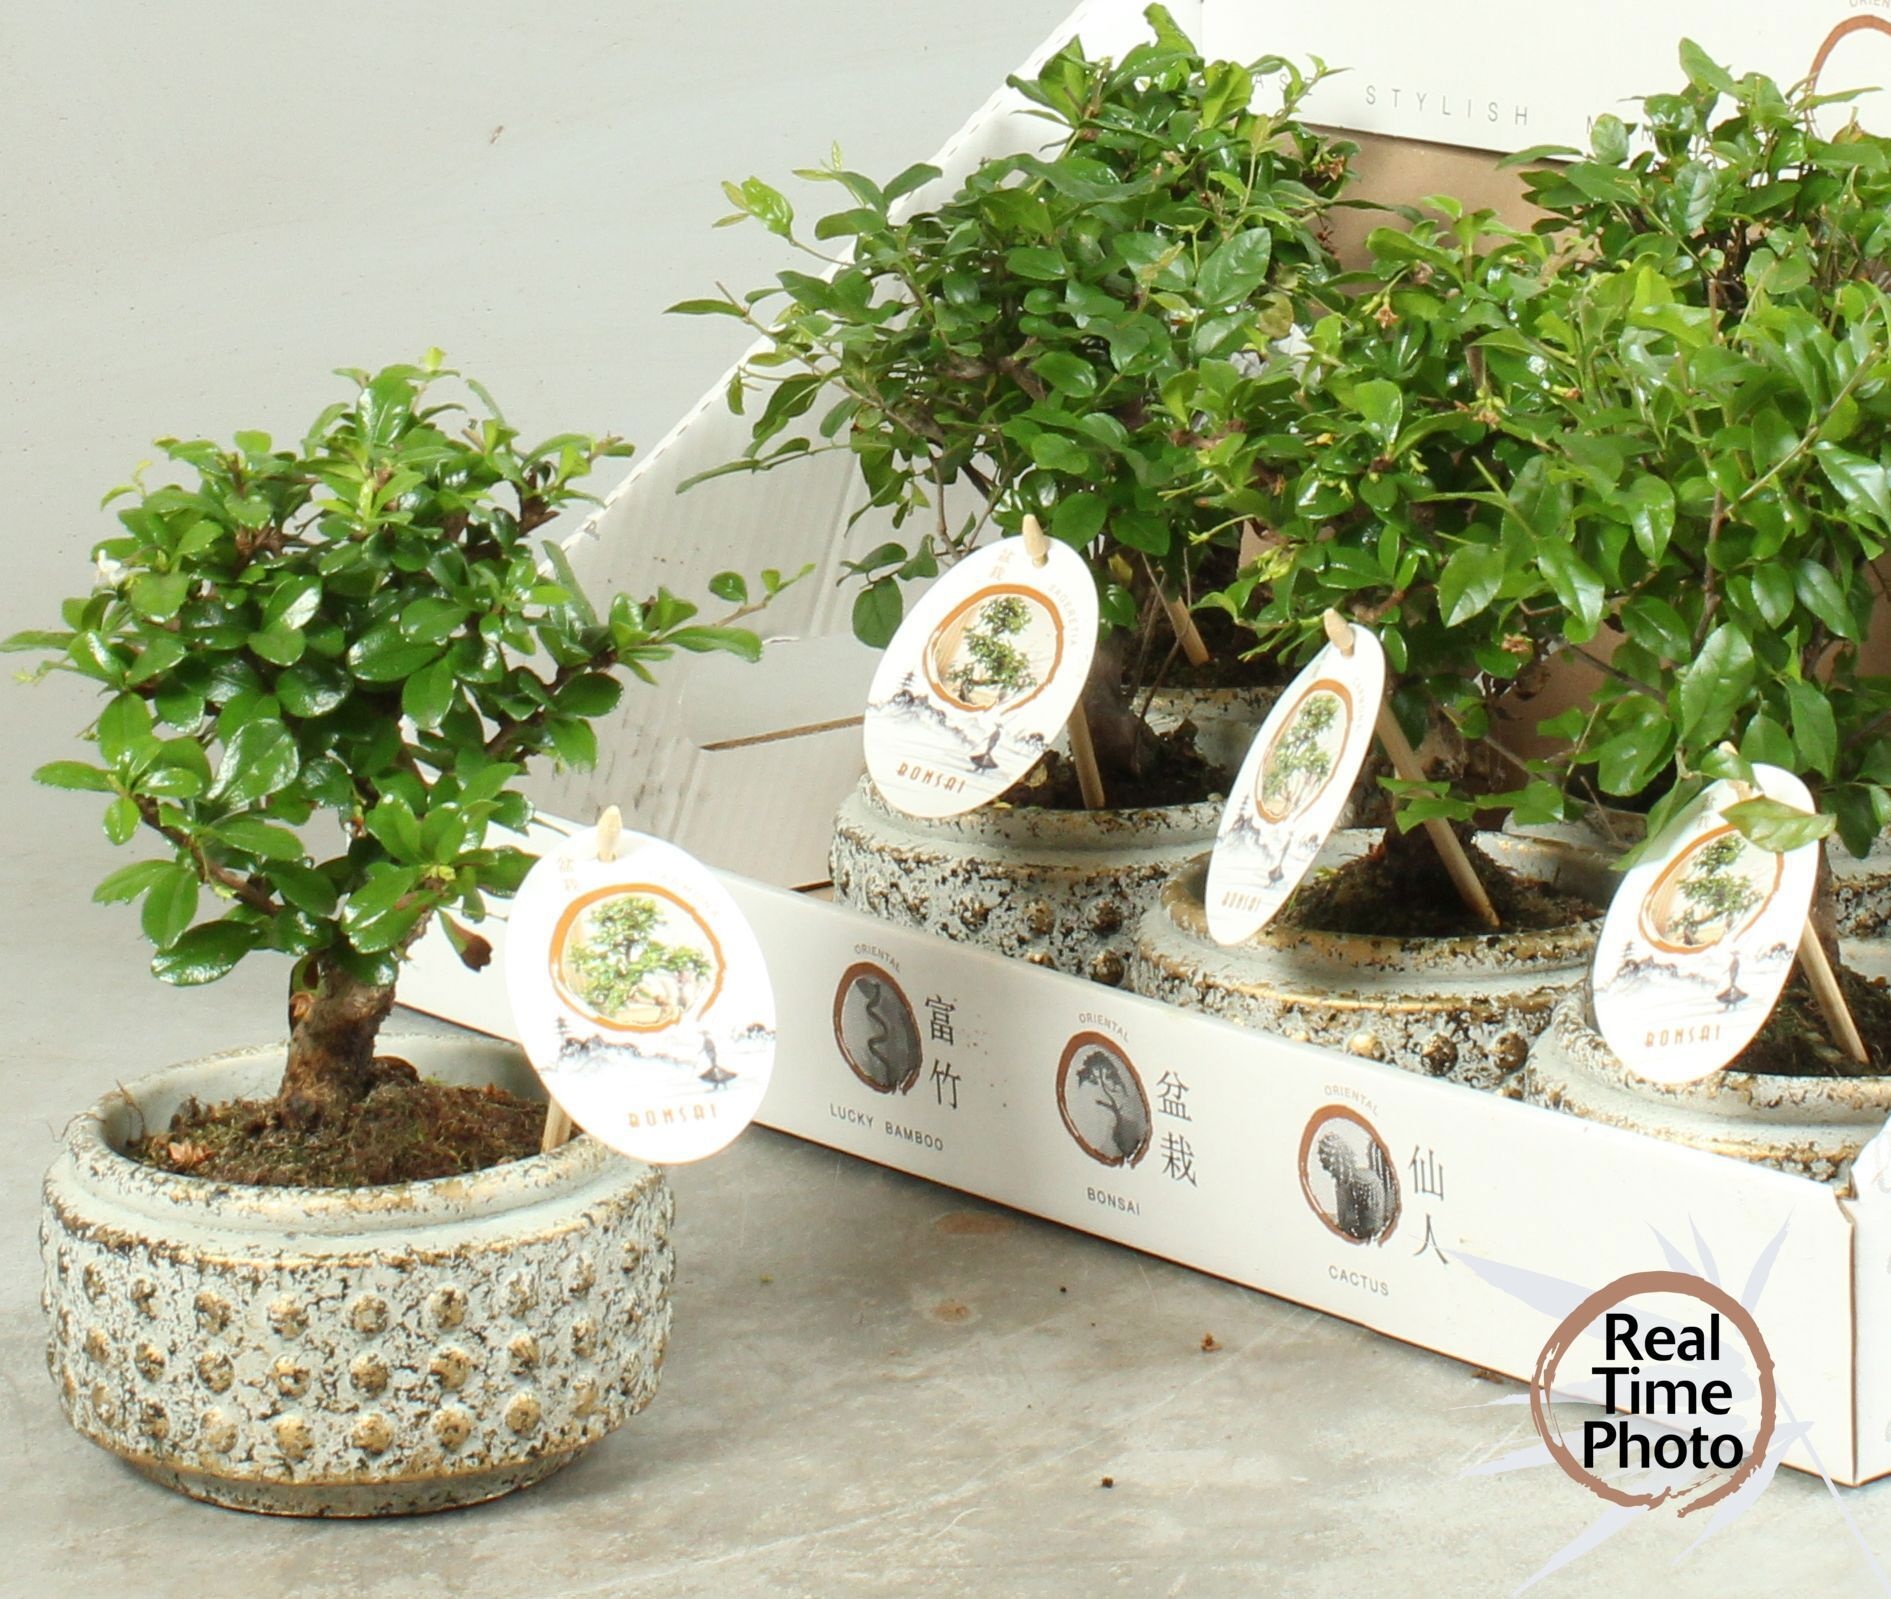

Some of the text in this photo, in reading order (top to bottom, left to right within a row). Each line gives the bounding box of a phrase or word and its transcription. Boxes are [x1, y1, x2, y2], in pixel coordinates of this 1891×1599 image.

[1366, 85, 1528, 126] STYLISH
[896, 761, 966, 794] BONSAI
[854, 944, 900, 973] ORIENTAL
[1078, 1013, 1129, 1042] ORIENTAL
[1644, 1024, 1721, 1048] BONSAI
[925, 995, 961, 1110] 富竹
[1324, 1084, 1379, 1115] ORIENTAL
[830, 1103, 944, 1152] LUCKY BAMBOO
[1157, 1070, 1197, 1187] 盆栽
[1087, 1186, 1140, 1216] BONSAI
[1409, 1145, 1449, 1265] 仙人
[1328, 1264, 1390, 1297] CACTUS
